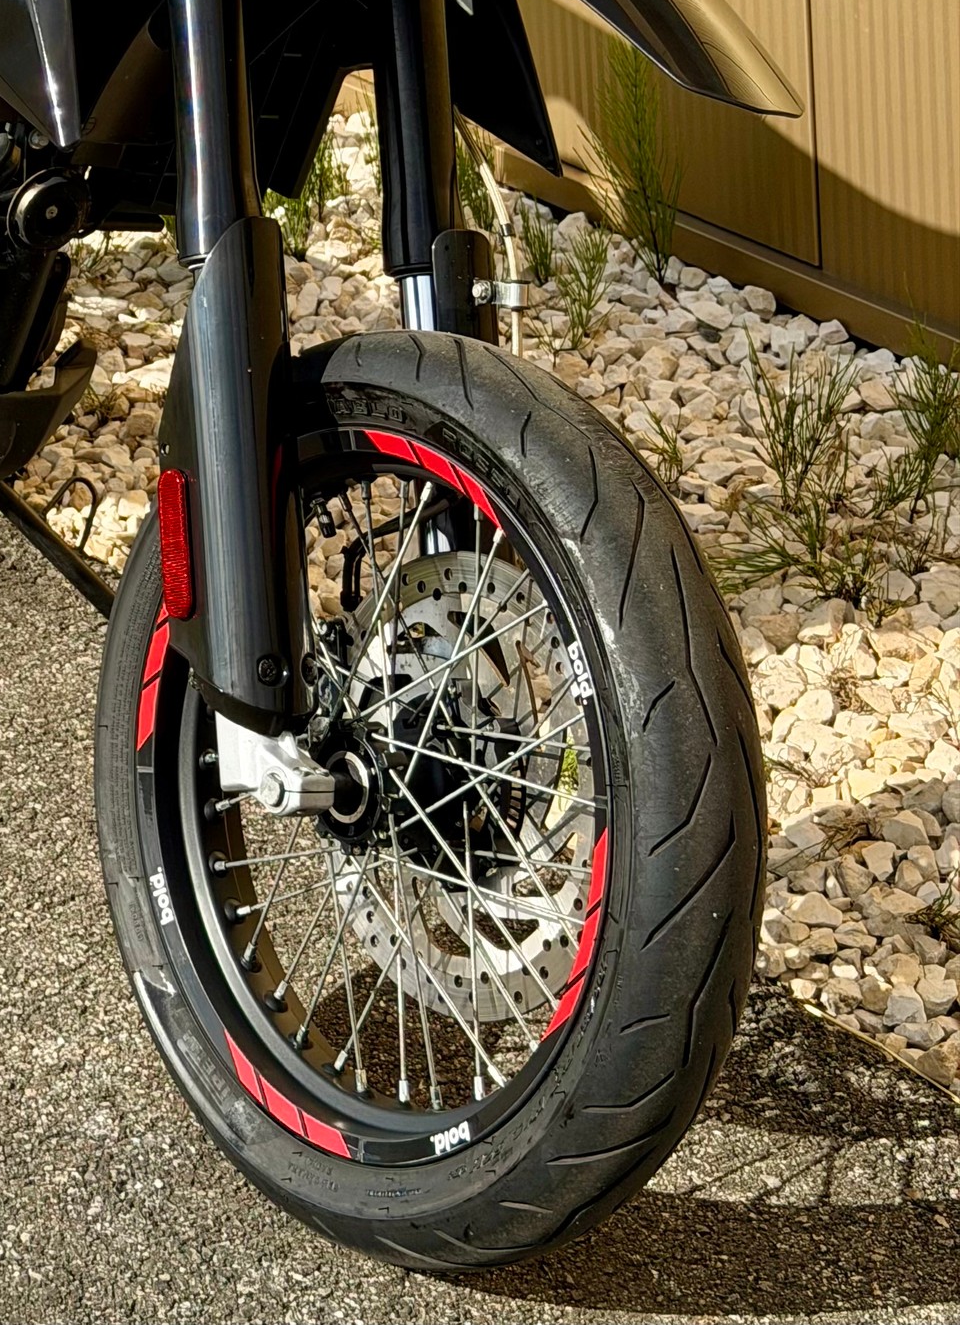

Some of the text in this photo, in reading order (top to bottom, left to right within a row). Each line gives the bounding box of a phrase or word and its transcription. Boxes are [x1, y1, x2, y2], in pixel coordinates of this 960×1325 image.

[567, 641, 593, 706] bold.
[149, 866, 174, 925] bold.
[430, 1120, 470, 1156] bold.
